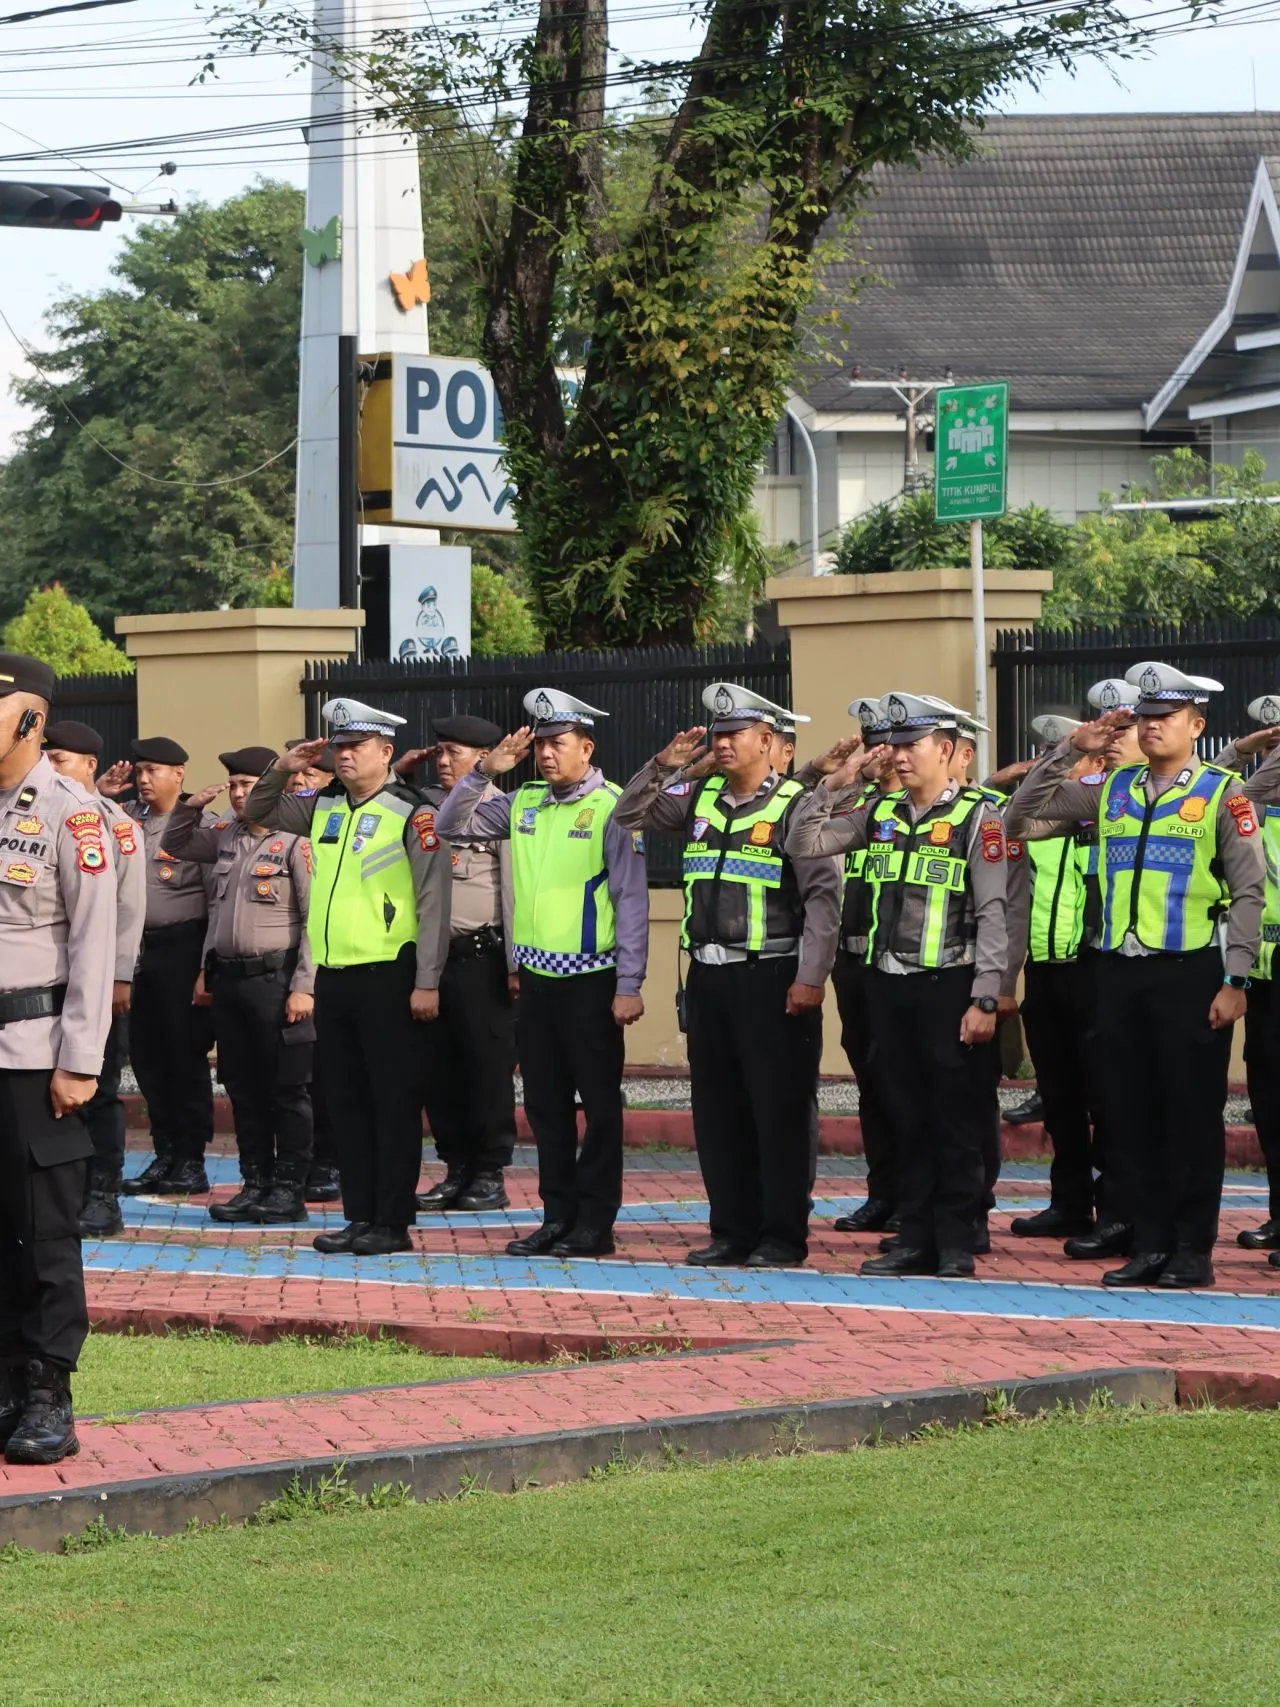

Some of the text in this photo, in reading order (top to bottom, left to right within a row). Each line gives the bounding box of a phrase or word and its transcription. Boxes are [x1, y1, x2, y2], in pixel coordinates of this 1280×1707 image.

[941, 483, 1000, 497] TITIK KUMPUL
[1169, 824, 1203, 837] POLRI
[743, 846, 771, 856] POLRI
[920, 846, 949, 856] POLRI
